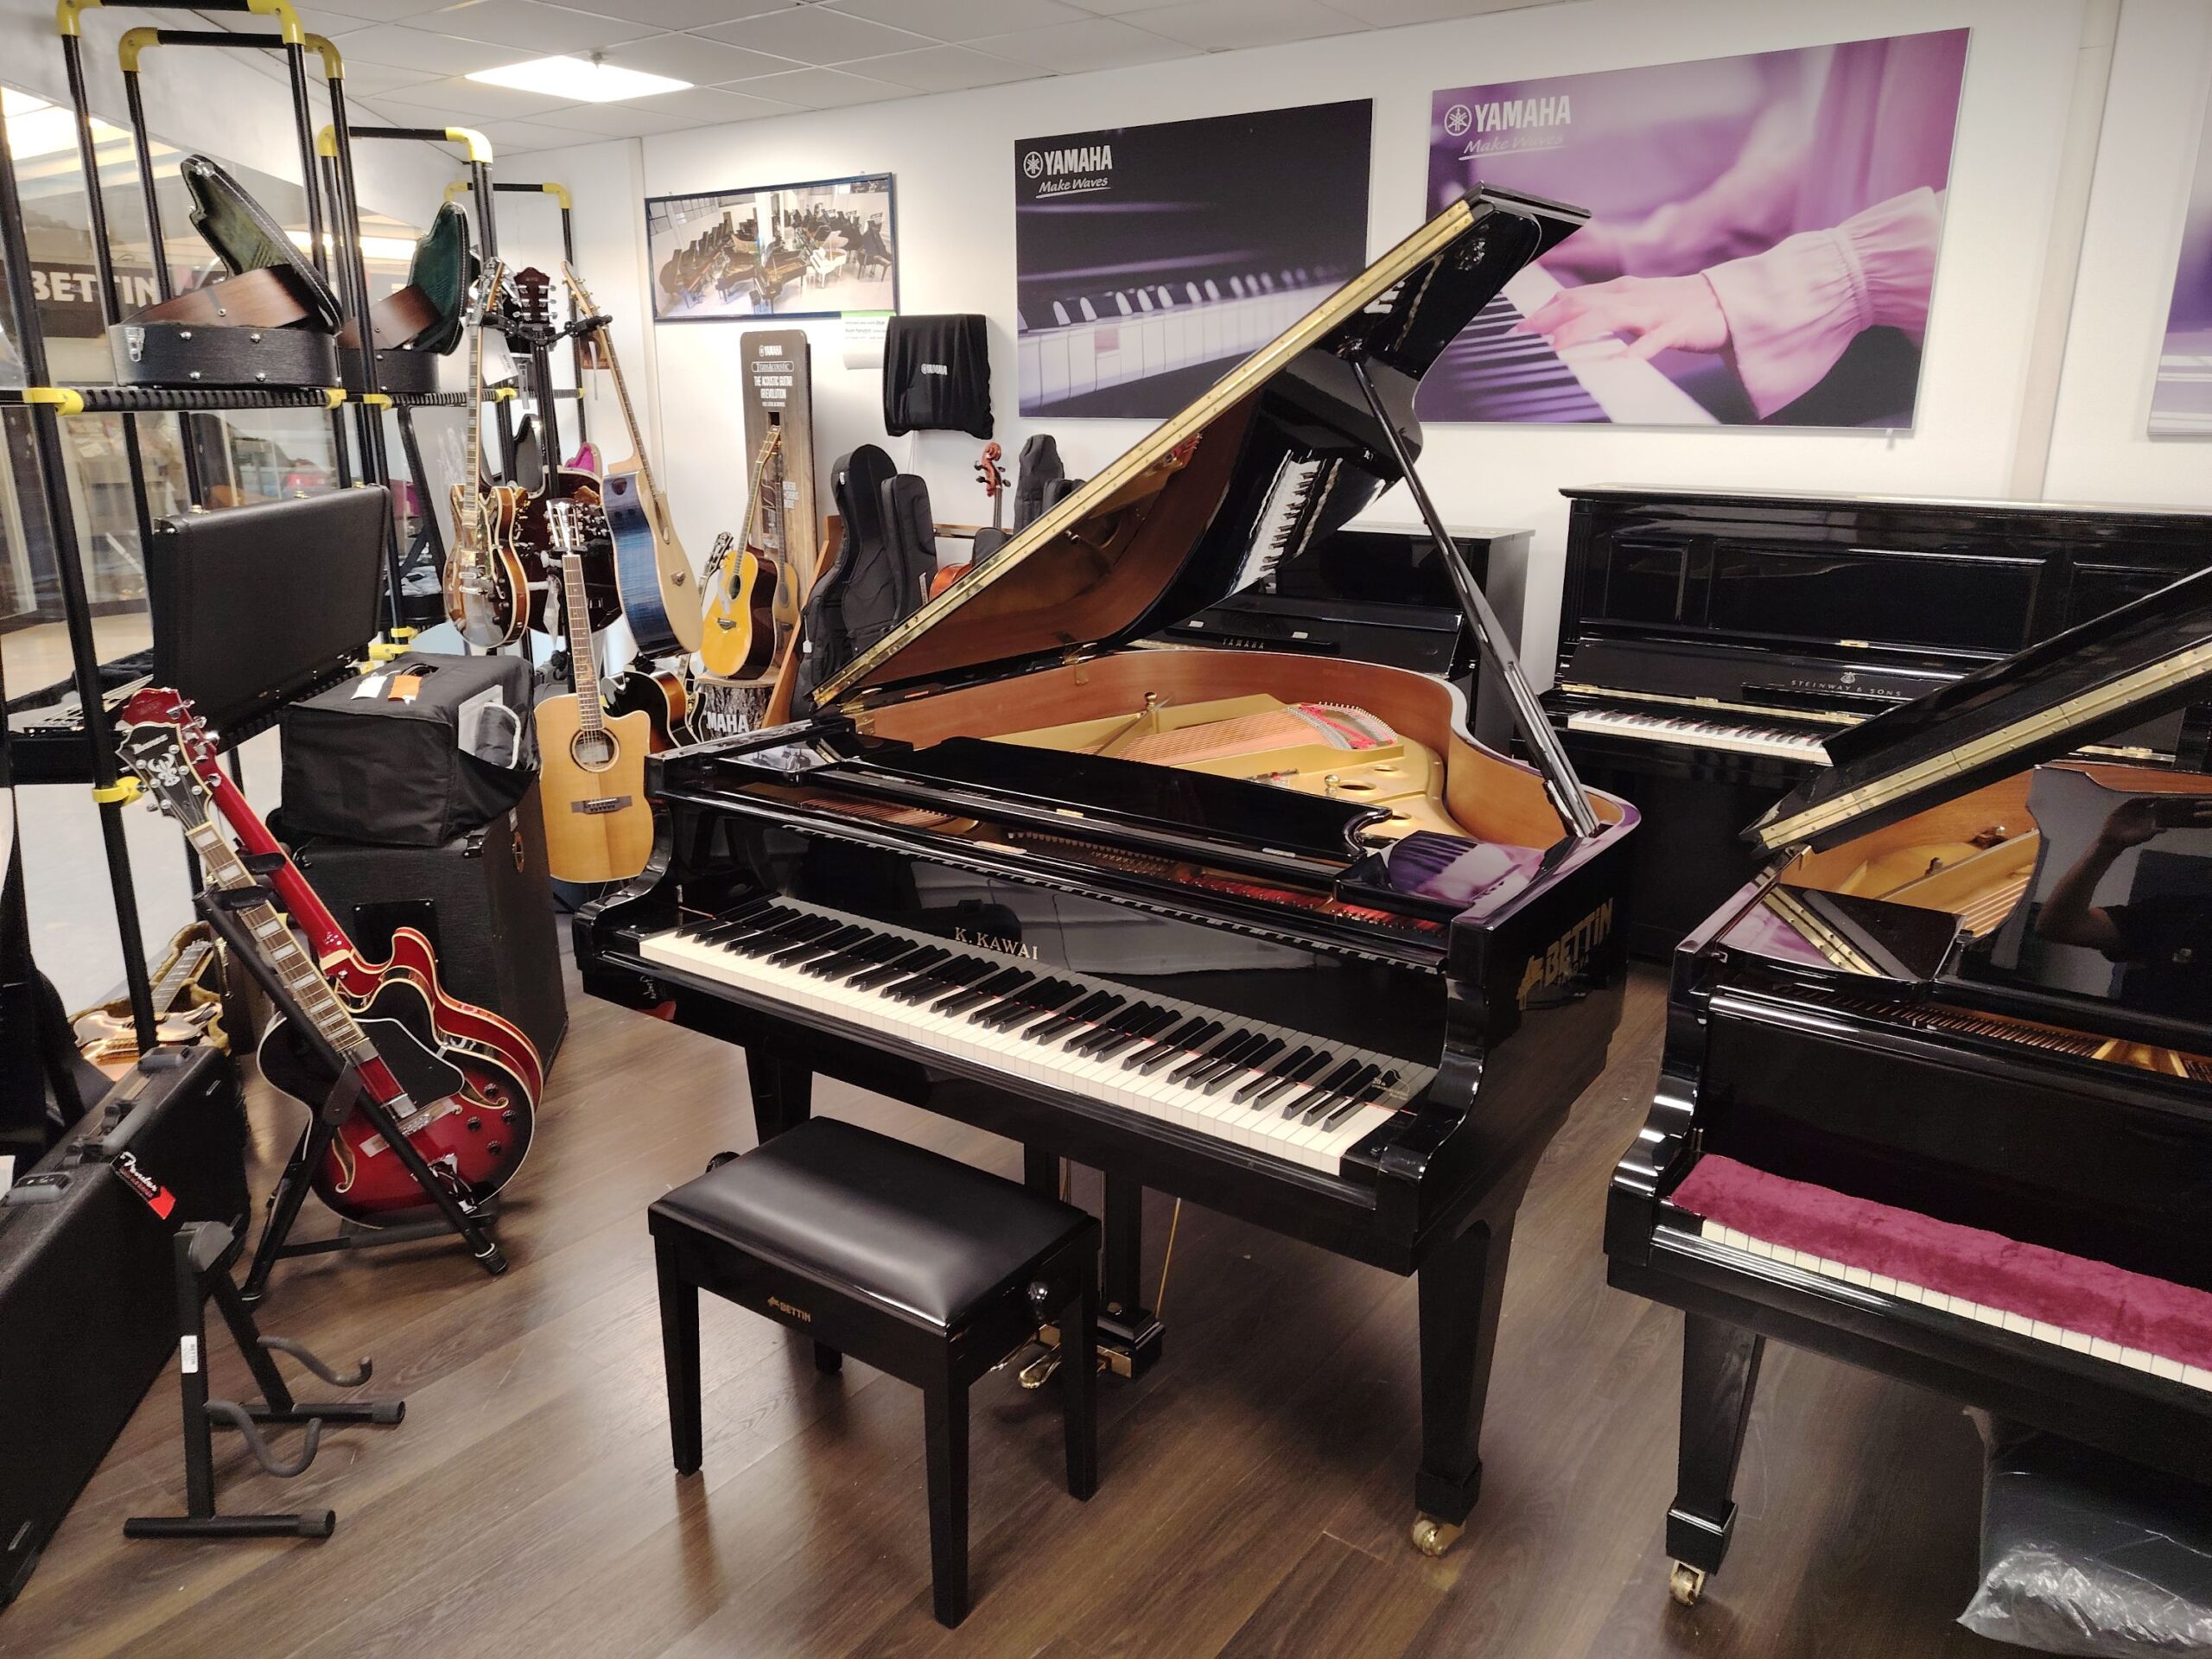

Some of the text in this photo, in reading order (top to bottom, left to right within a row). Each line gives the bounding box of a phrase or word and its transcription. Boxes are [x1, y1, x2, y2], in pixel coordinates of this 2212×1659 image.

[1474, 95, 1572, 133] YAMAHA
[1463, 134, 1563, 154] Make Waves
[1044, 145, 1113, 175] YAMAHA
[1039, 177, 1109, 193] Make Waves
[30, 270, 162, 308] BETIN
[1223, 637, 1265, 650] YAMAHA
[1791, 680, 1853, 691] STEINWAY
[1870, 688, 1902, 697] SONS
[706, 710, 750, 734] MAHA
[120, 1151, 157, 1192] Fender
